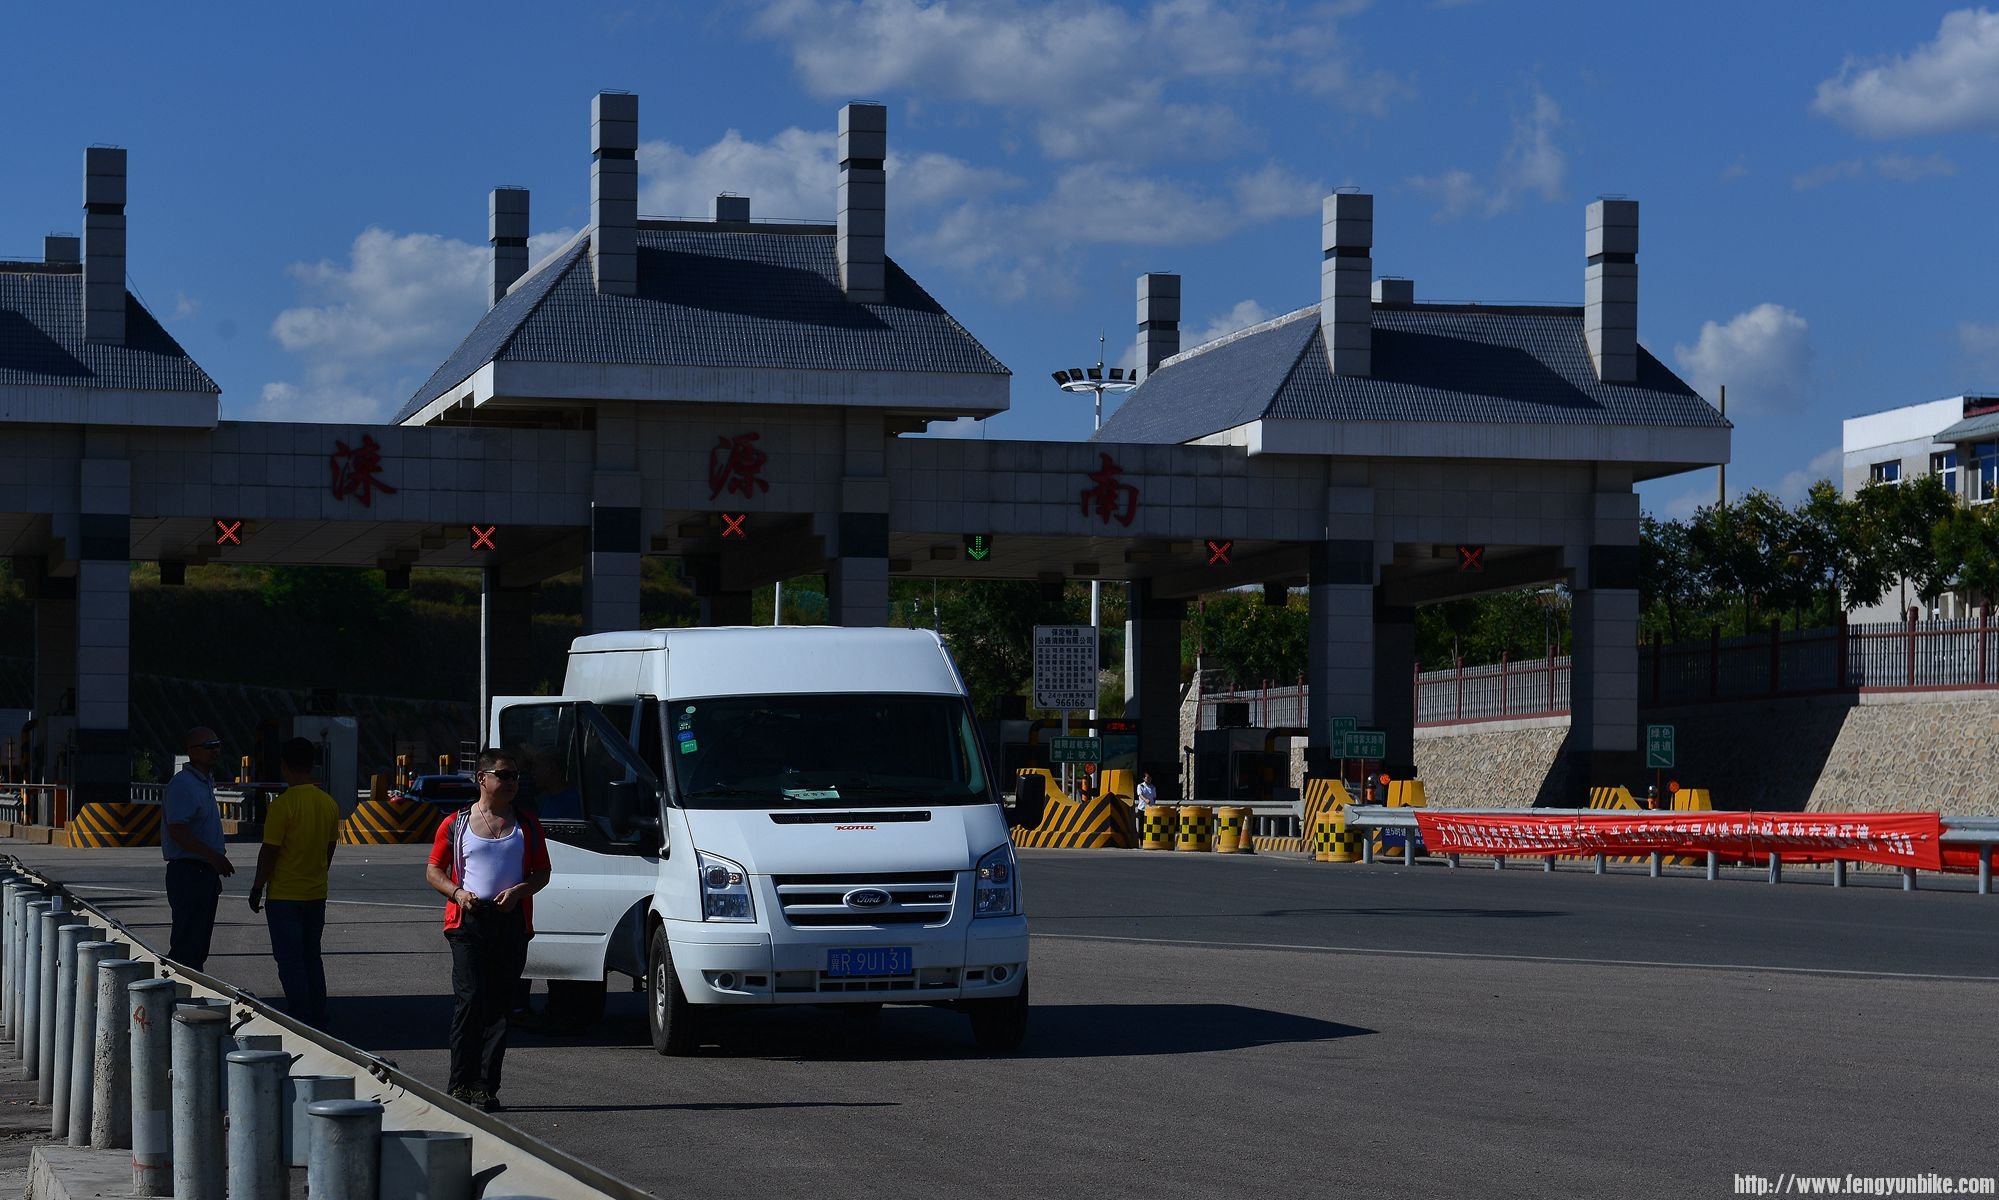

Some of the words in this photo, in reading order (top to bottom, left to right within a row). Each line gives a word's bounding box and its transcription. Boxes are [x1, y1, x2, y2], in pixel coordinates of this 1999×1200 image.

[708, 431, 769, 501] 源
[1081, 452, 1139, 528] 南
[1055, 698, 1085, 707] 966166
[1651, 728, 1671, 738] 绿色
[1651, 741, 1671, 752] 通道
[1054, 750, 1099, 760] 禁止驶入
